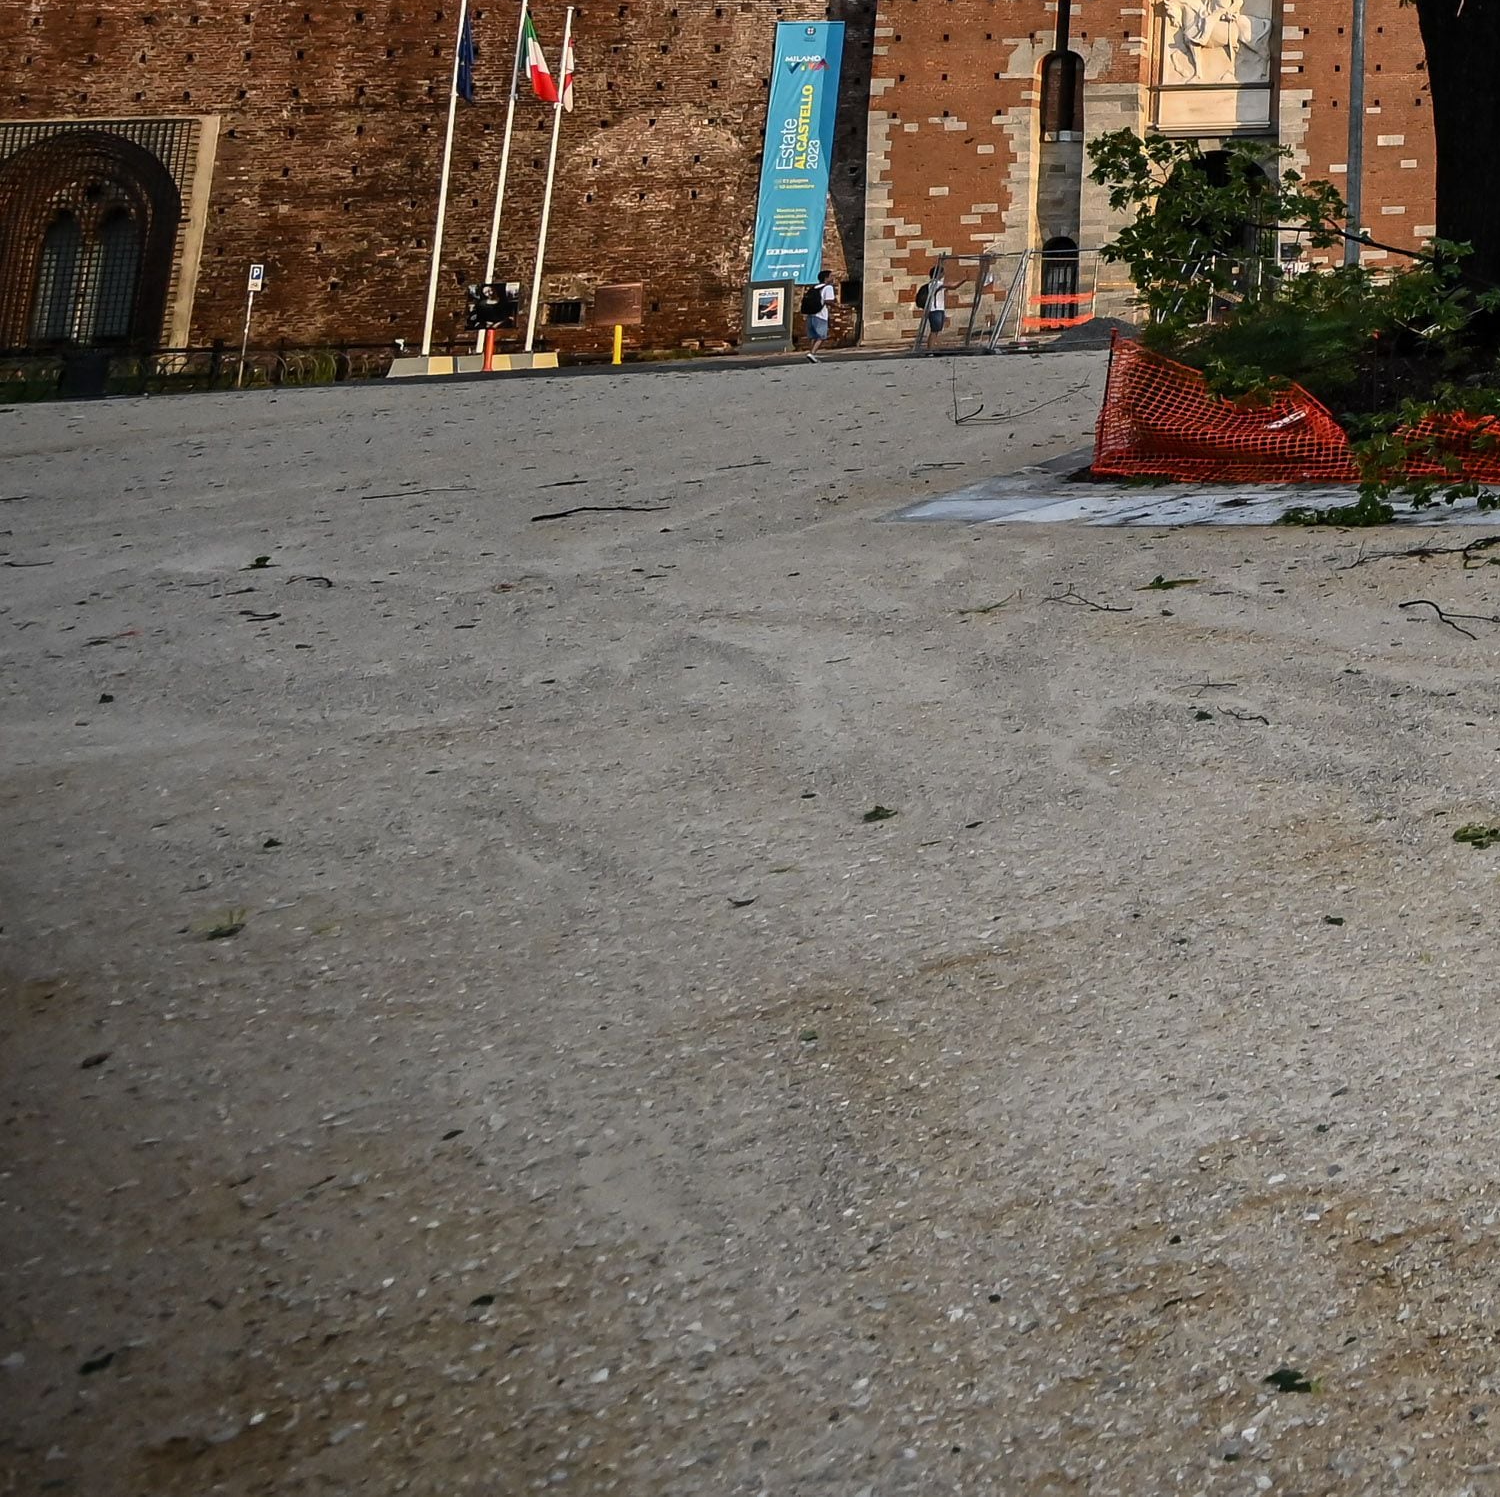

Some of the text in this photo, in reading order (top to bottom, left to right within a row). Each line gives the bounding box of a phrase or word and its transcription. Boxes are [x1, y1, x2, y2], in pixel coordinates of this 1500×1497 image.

[776, 118, 798, 170] Estate
[794, 84, 814, 169] AL CASTELLO
[806, 139, 820, 169] 2023
[253, 268, 260, 278] P
